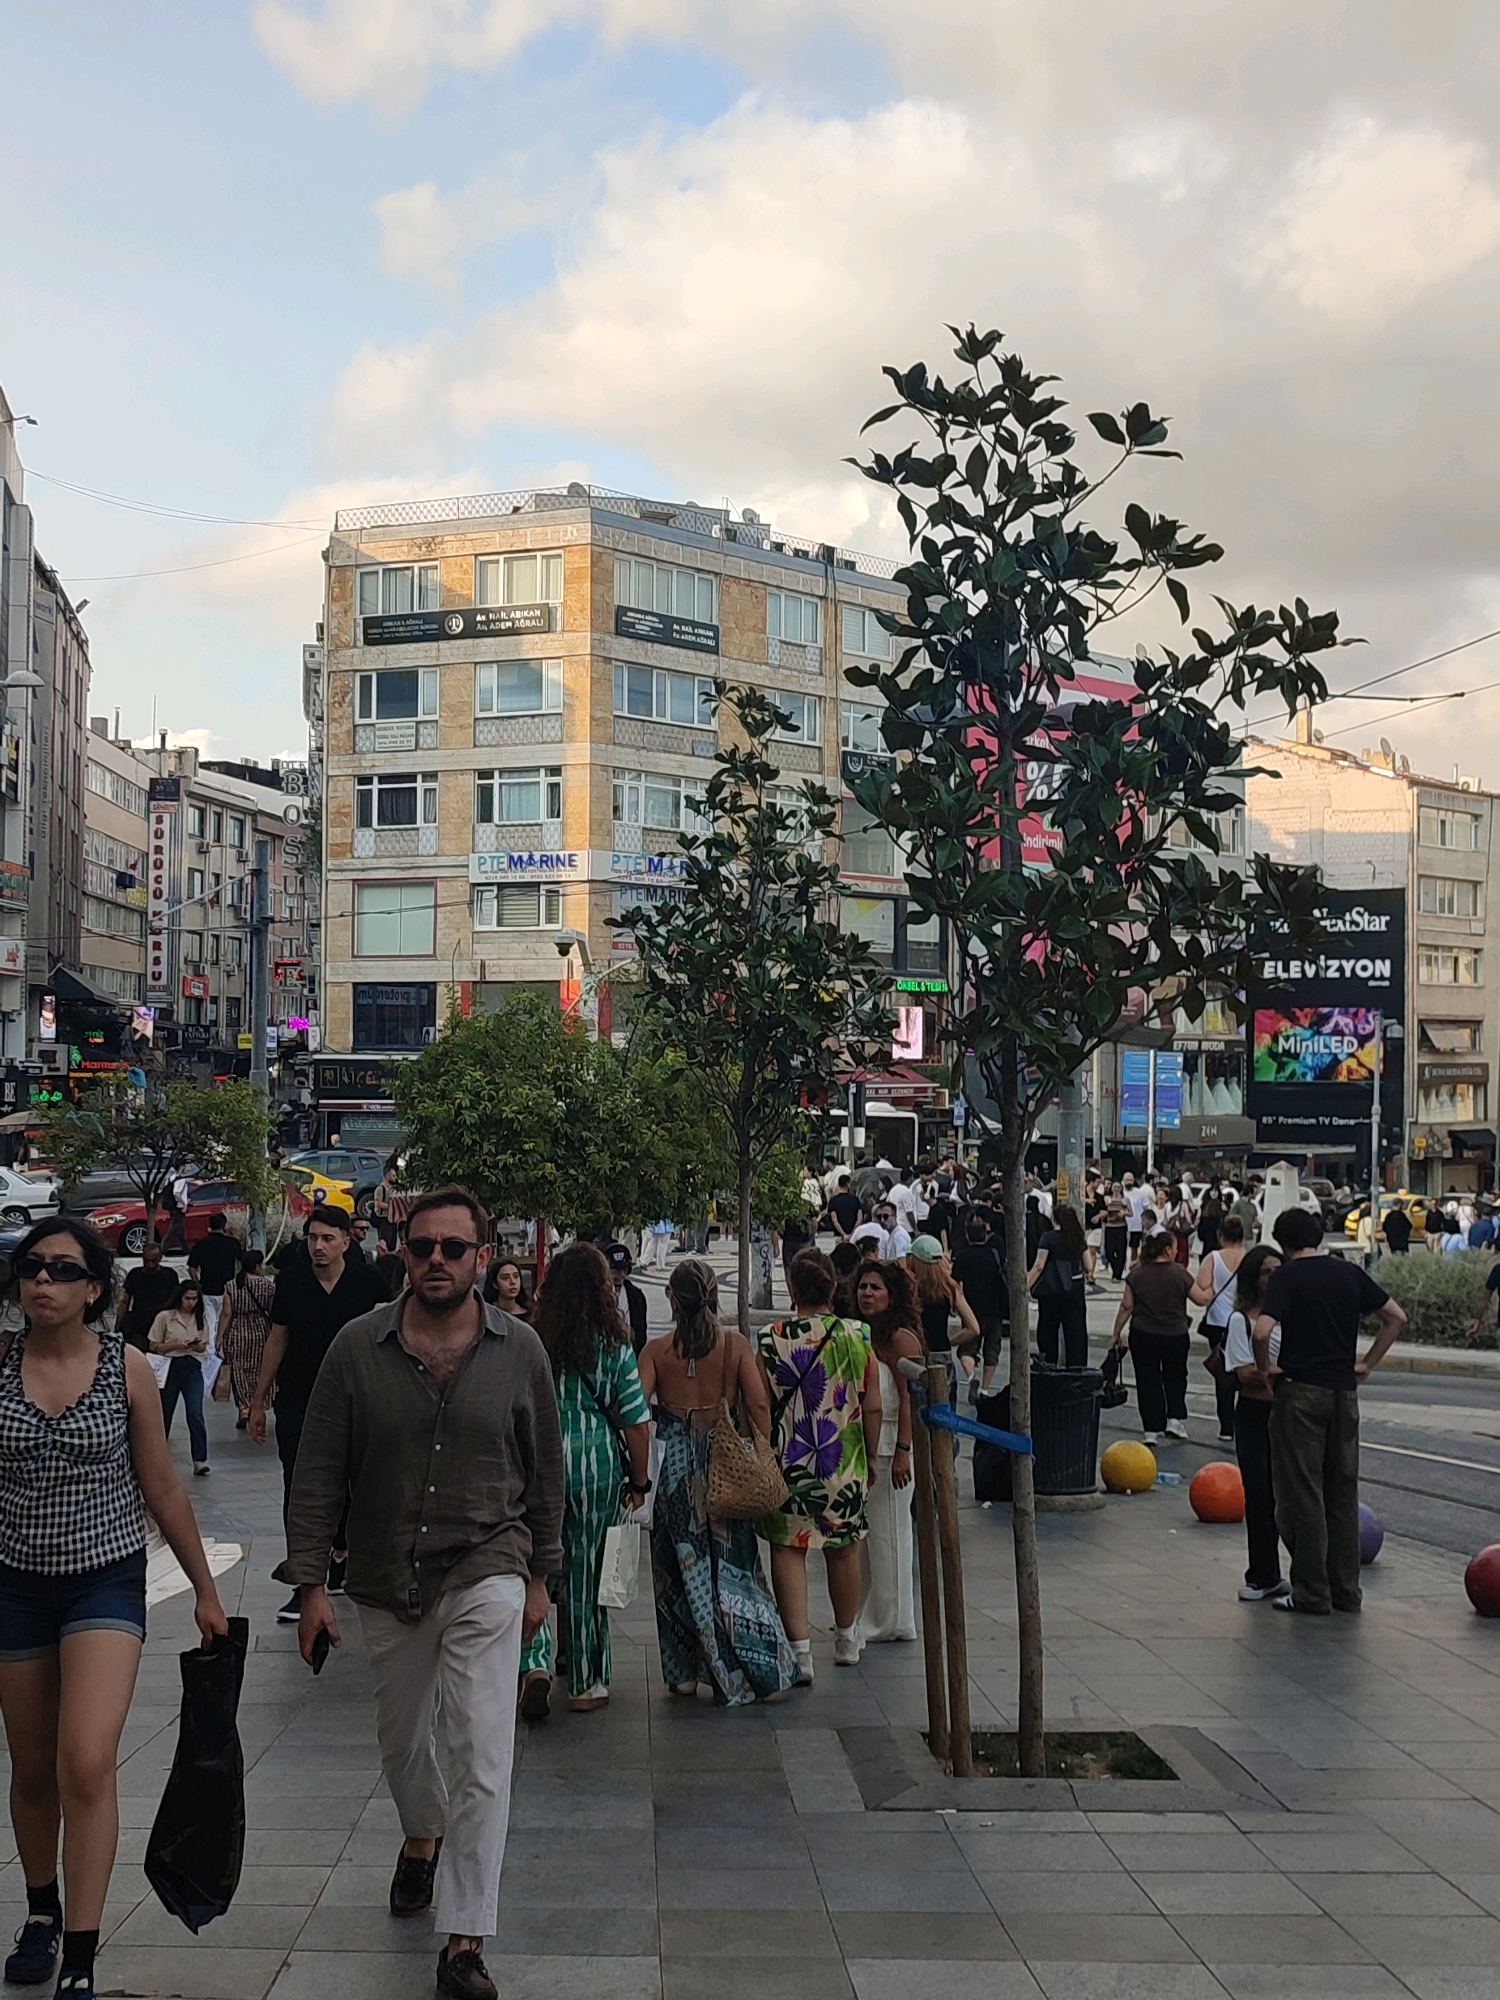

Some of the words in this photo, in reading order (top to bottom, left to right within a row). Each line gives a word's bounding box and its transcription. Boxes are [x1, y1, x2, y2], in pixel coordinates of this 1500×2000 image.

[510, 608, 541, 620] ARIKAN
[489, 620, 513, 631] ADEM
[514, 617, 544, 630] AĞRALI
[153, 814, 165, 901] SÜRÜCÜ
[1278, 1035, 1359, 1054] MiniLED
[1278, 1115, 1317, 1126] Premium
[1318, 1116, 1331, 1126] TV
[1201, 1125, 1217, 1138] ZEN
